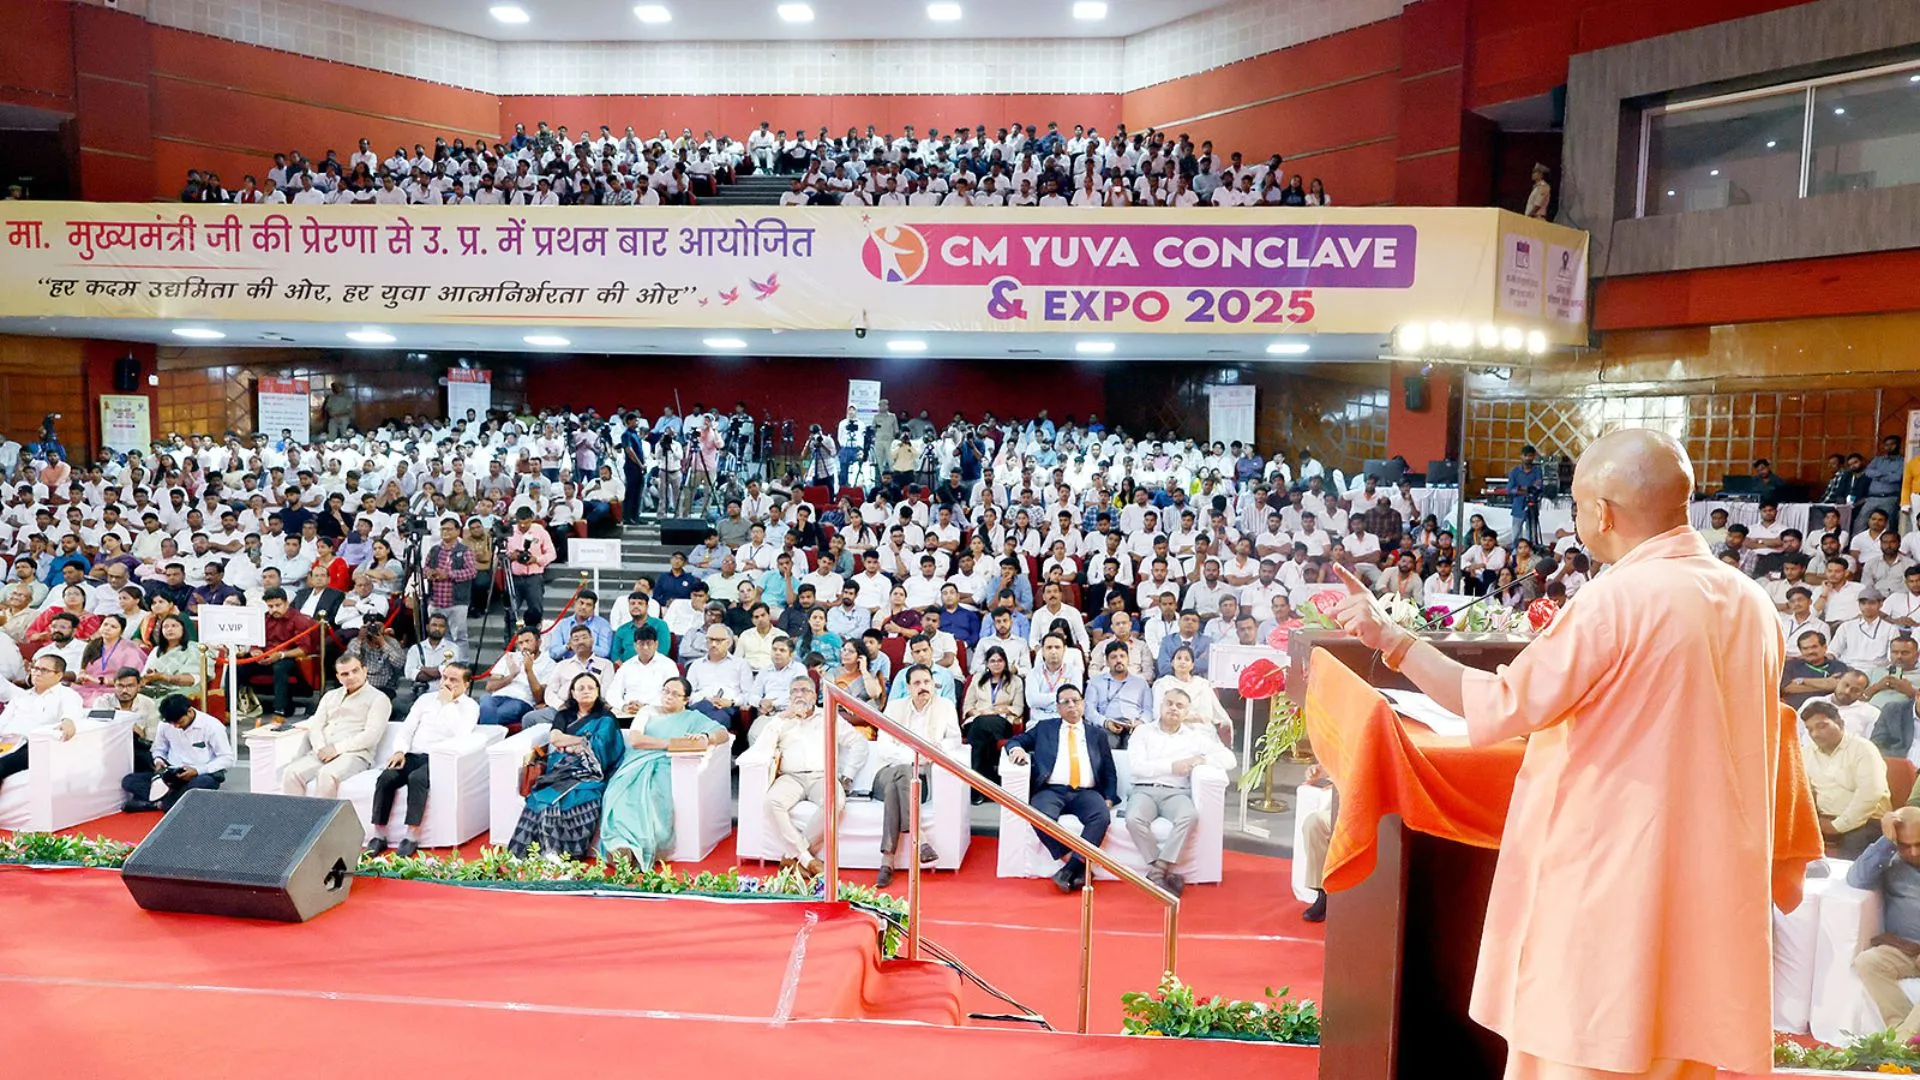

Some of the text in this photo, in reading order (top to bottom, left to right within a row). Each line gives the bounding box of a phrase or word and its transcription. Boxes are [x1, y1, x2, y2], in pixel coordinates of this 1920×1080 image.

[6, 214, 816, 261] मा. मुख्यमंत्री जी की प्रेरणा से उ. प्र. में प्रथम बार आयोजित
[941, 236, 1398, 269] CM YUVA CONCLAVE
[85, 279, 137, 297] कदम
[148, 276, 239, 299] उद्यमिता
[246, 276, 279, 299] की
[283, 278, 333, 303] ओर,
[343, 284, 371, 303] हर
[380, 285, 431, 308] युवा
[438, 280, 589, 304] आत्मनिर्भरता
[597, 280, 630, 304] की
[987, 278, 1316, 324] & EXPO 2025
[217, 623, 243, 632] V.VIP
